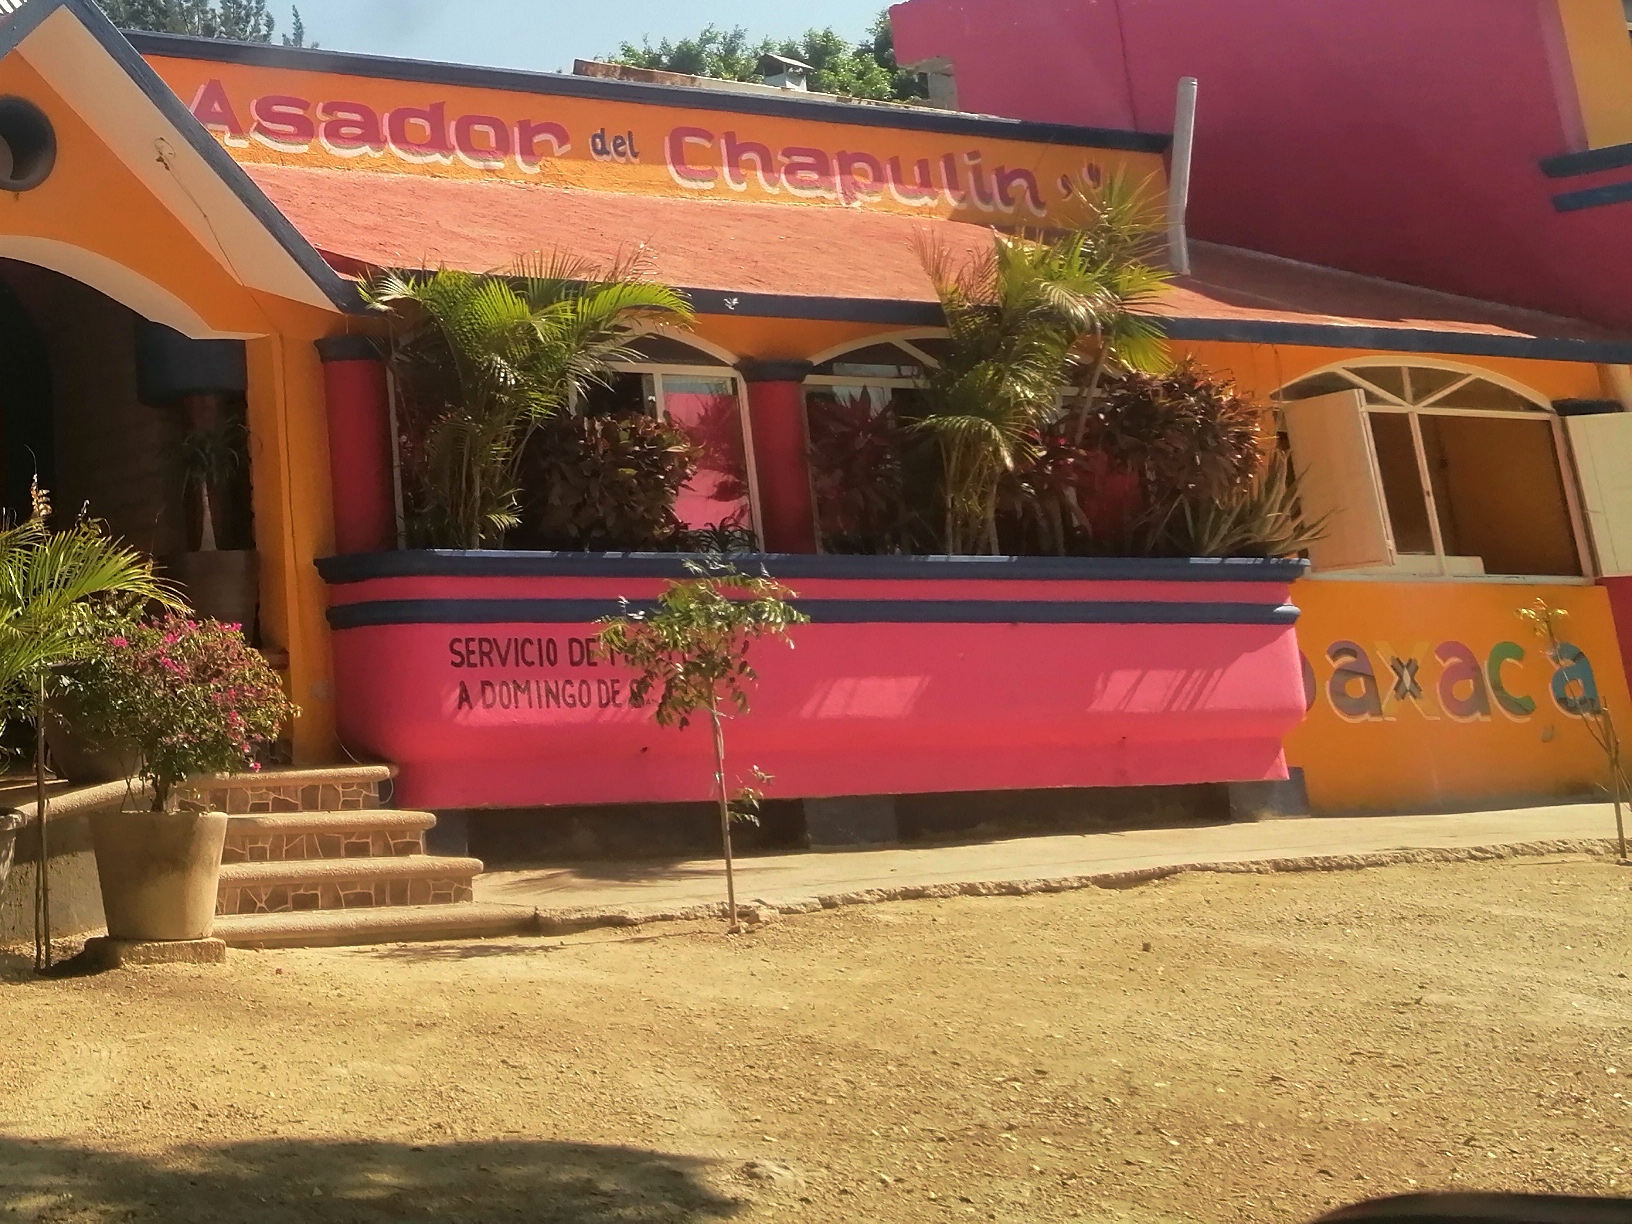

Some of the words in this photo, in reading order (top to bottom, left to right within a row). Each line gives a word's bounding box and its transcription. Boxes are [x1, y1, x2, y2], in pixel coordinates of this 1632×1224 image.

[190, 77, 571, 174] Asador
[590, 126, 641, 164] del
[449, 637, 558, 668] SERVICIO
[568, 637, 599, 667] DE
[1300, 639, 1605, 724] axaca
[457, 680, 474, 710] A
[480, 678, 592, 710] DOMINGO
[597, 678, 623, 709] DE
